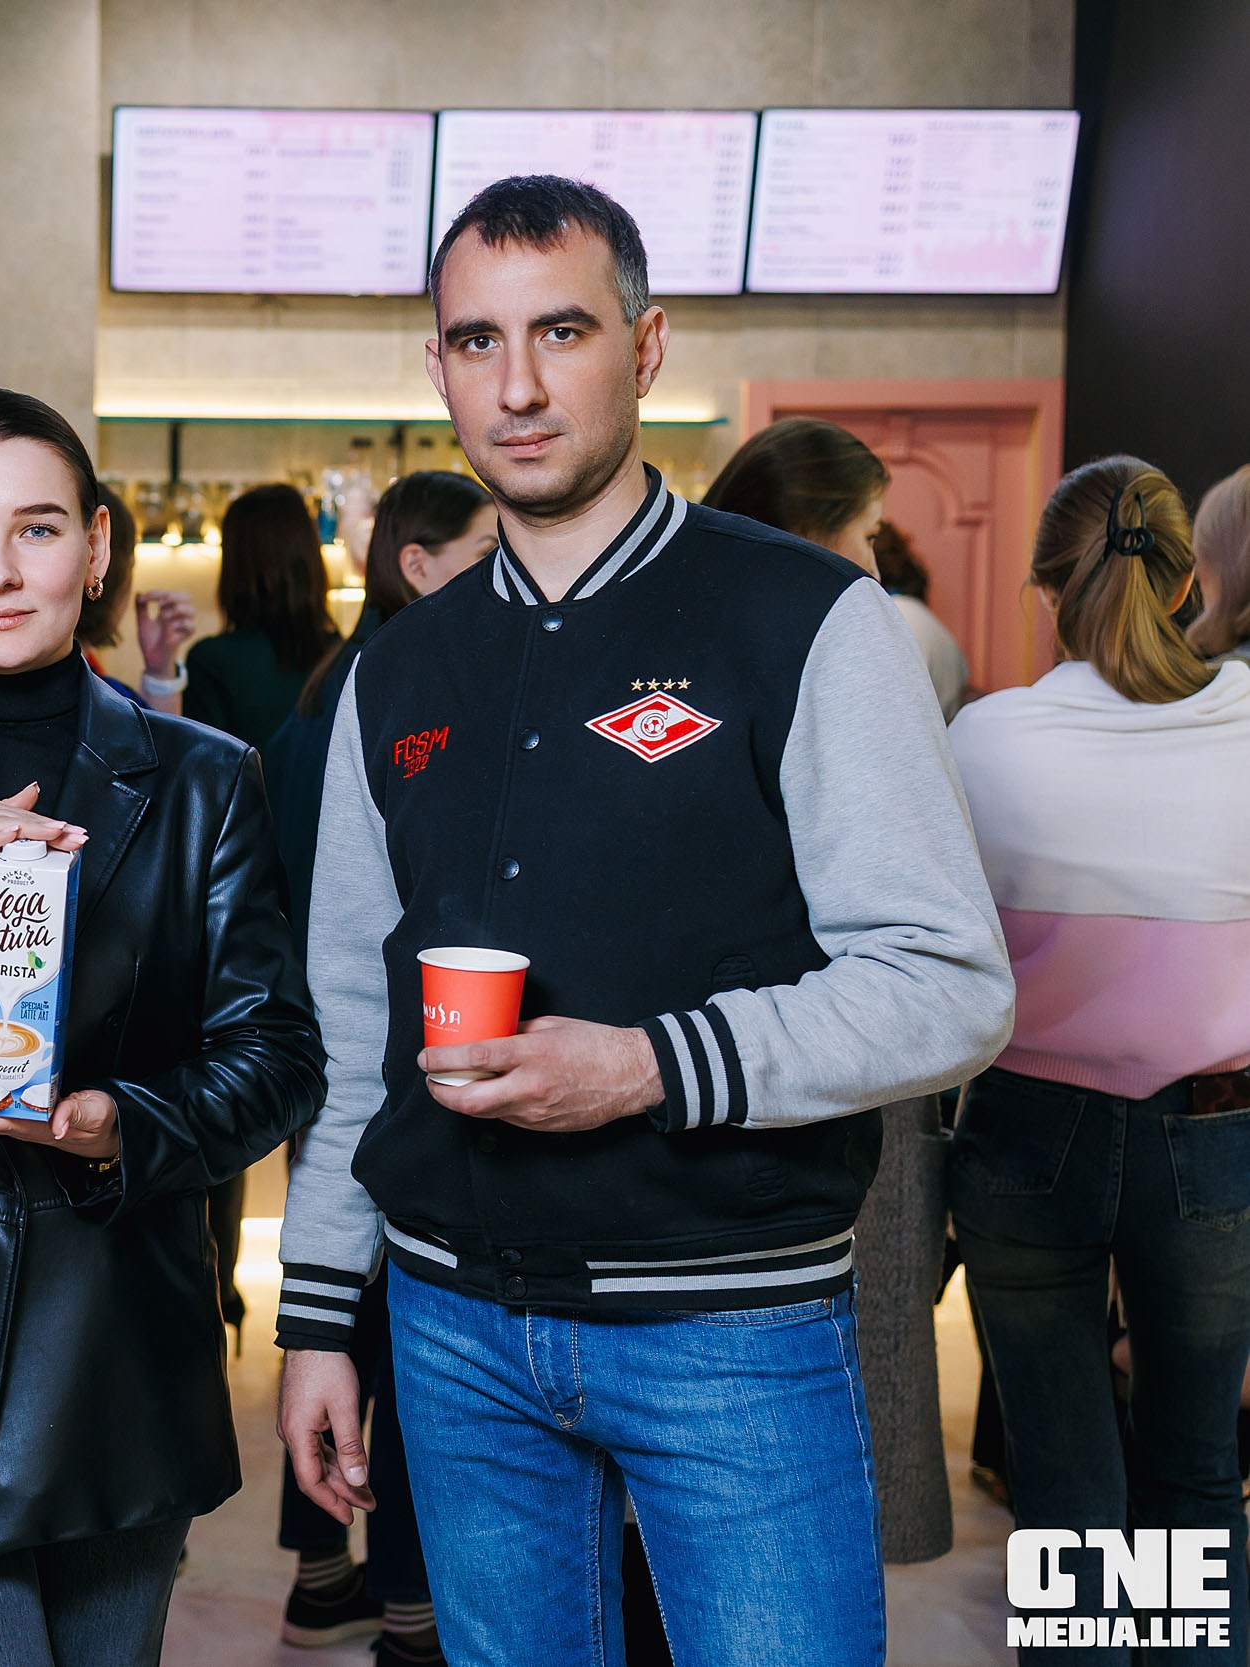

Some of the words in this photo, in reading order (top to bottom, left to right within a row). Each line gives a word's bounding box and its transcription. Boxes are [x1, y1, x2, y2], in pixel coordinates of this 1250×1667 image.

[393, 725, 449, 765] FCSM
[1, 870, 35, 885] MILKLESS
[20, 1001, 44, 1010] SPECIAL
[20, 1009, 36, 1020] LATTE
[38, 1010, 49, 1021] ART
